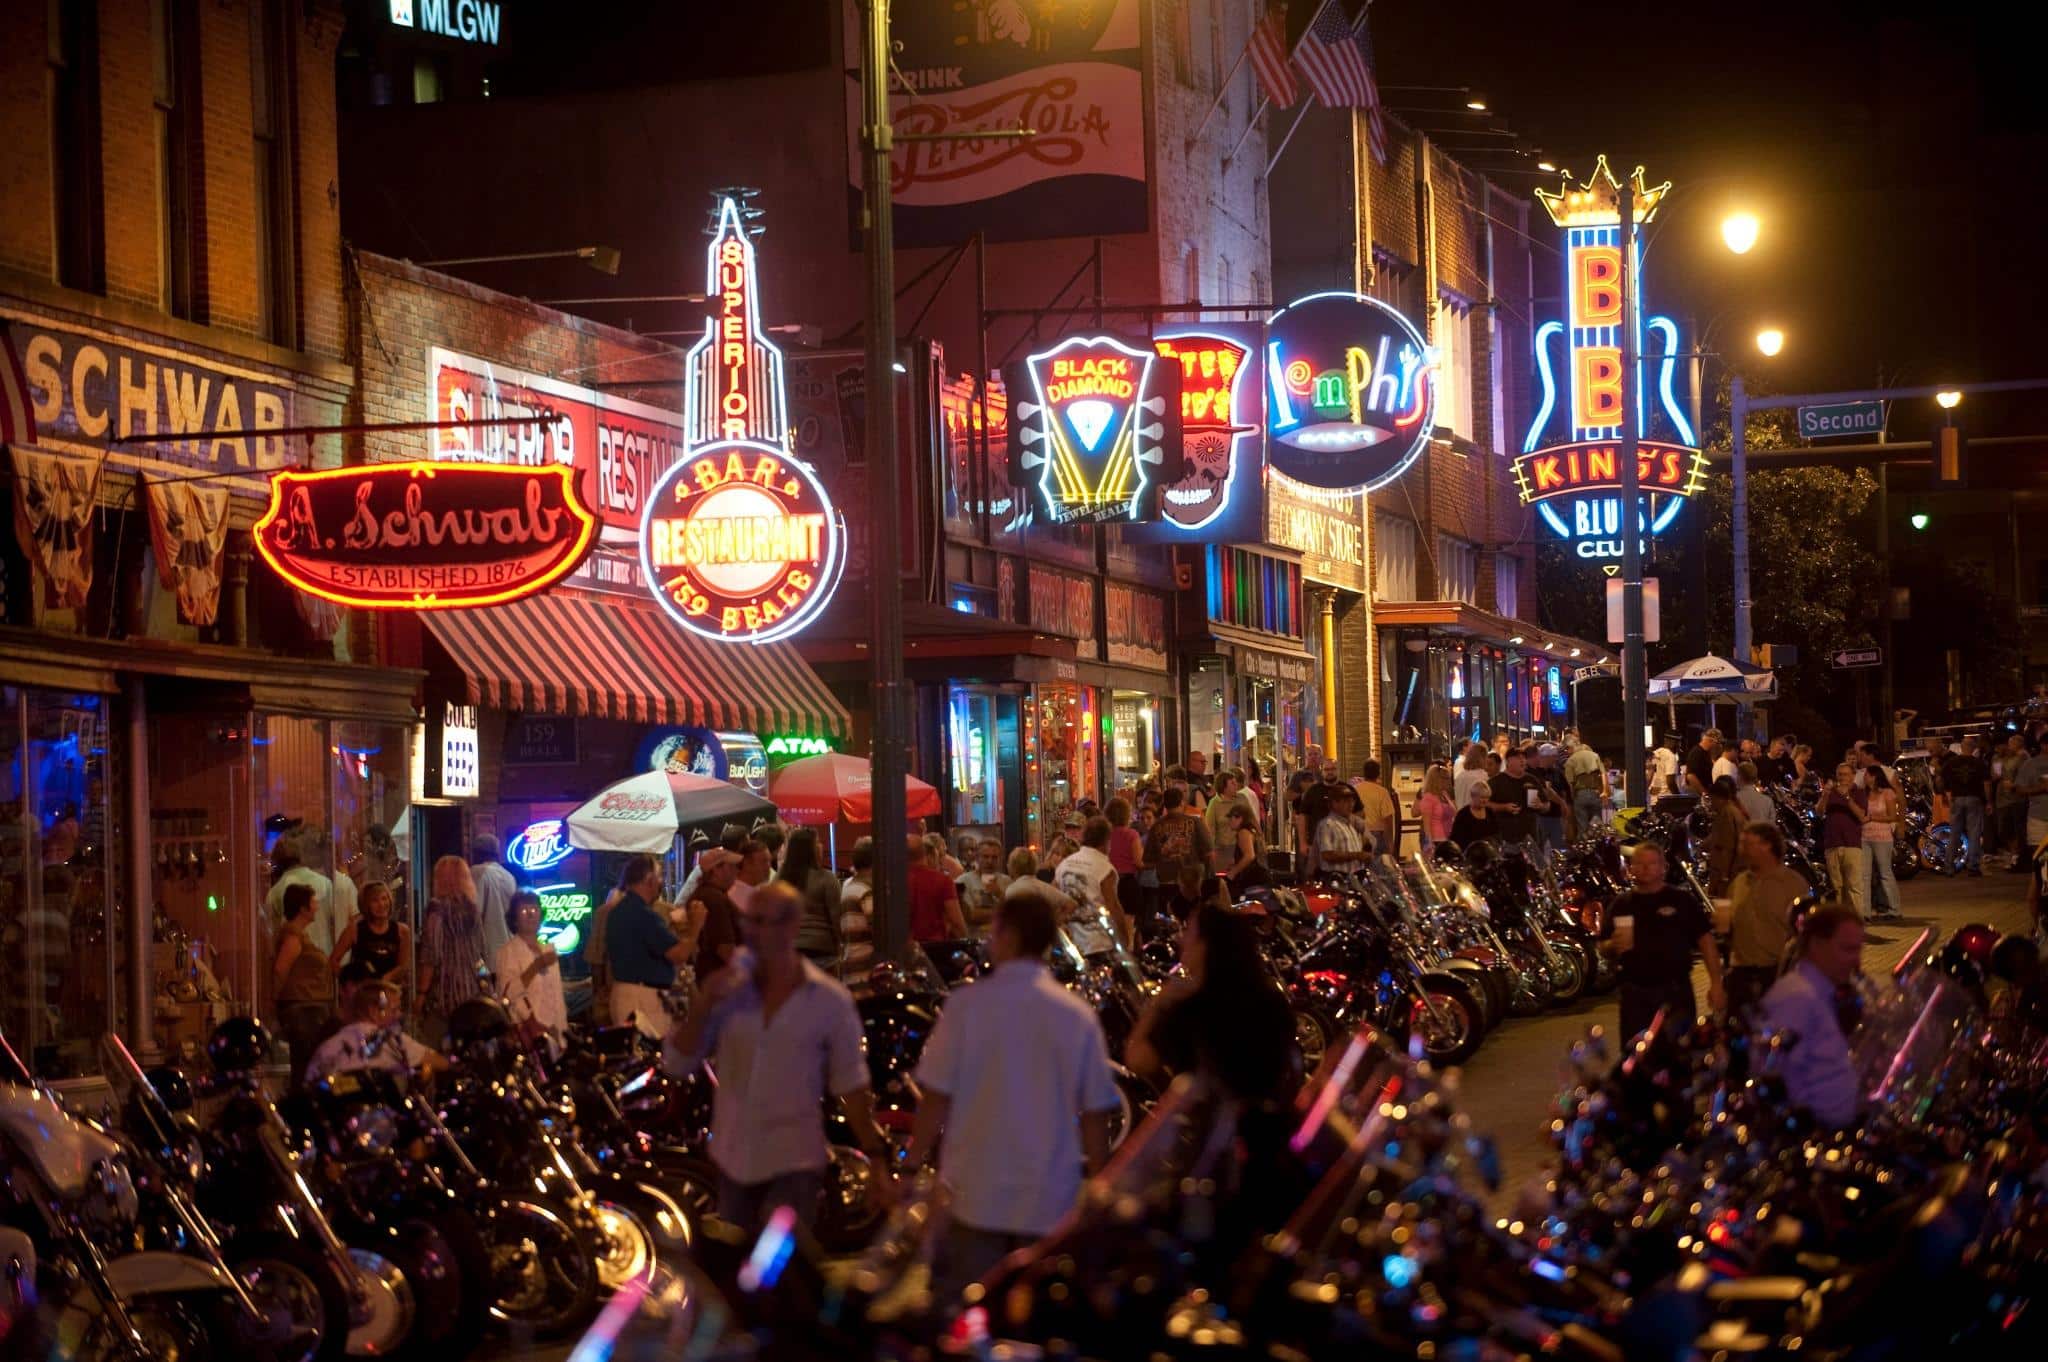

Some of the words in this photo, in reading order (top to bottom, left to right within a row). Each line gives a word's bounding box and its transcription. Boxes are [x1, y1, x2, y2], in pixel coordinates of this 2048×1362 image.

[421, 0, 499, 45] MLGW
[888, 66, 963, 92] DRINK
[722, 240, 748, 441] SUPERIOR
[1053, 358, 1128, 377] BLACK
[25, 335, 286, 470] SCHWAB
[1047, 375, 1133, 404] DIAMOND
[1806, 410, 1877, 431] Second
[693, 451, 779, 491] BAR
[275, 486, 334, 549] A.
[344, 478, 562, 549] Schwab
[1056, 505, 1092, 524] JEWEL
[1095, 501, 1130, 521] BEALE
[1575, 497, 1645, 535] BLUS
[652, 513, 825, 566] RESTAURANT
[1279, 504, 1326, 555] COMPANY
[1329, 516, 1362, 566] STORE
[330, 564, 478, 589] ESTABLISHED
[485, 561, 526, 585] 1876
[665, 575, 709, 616] 159
[721, 570, 813, 631] BEALE
[767, 738, 828, 754] ATM
